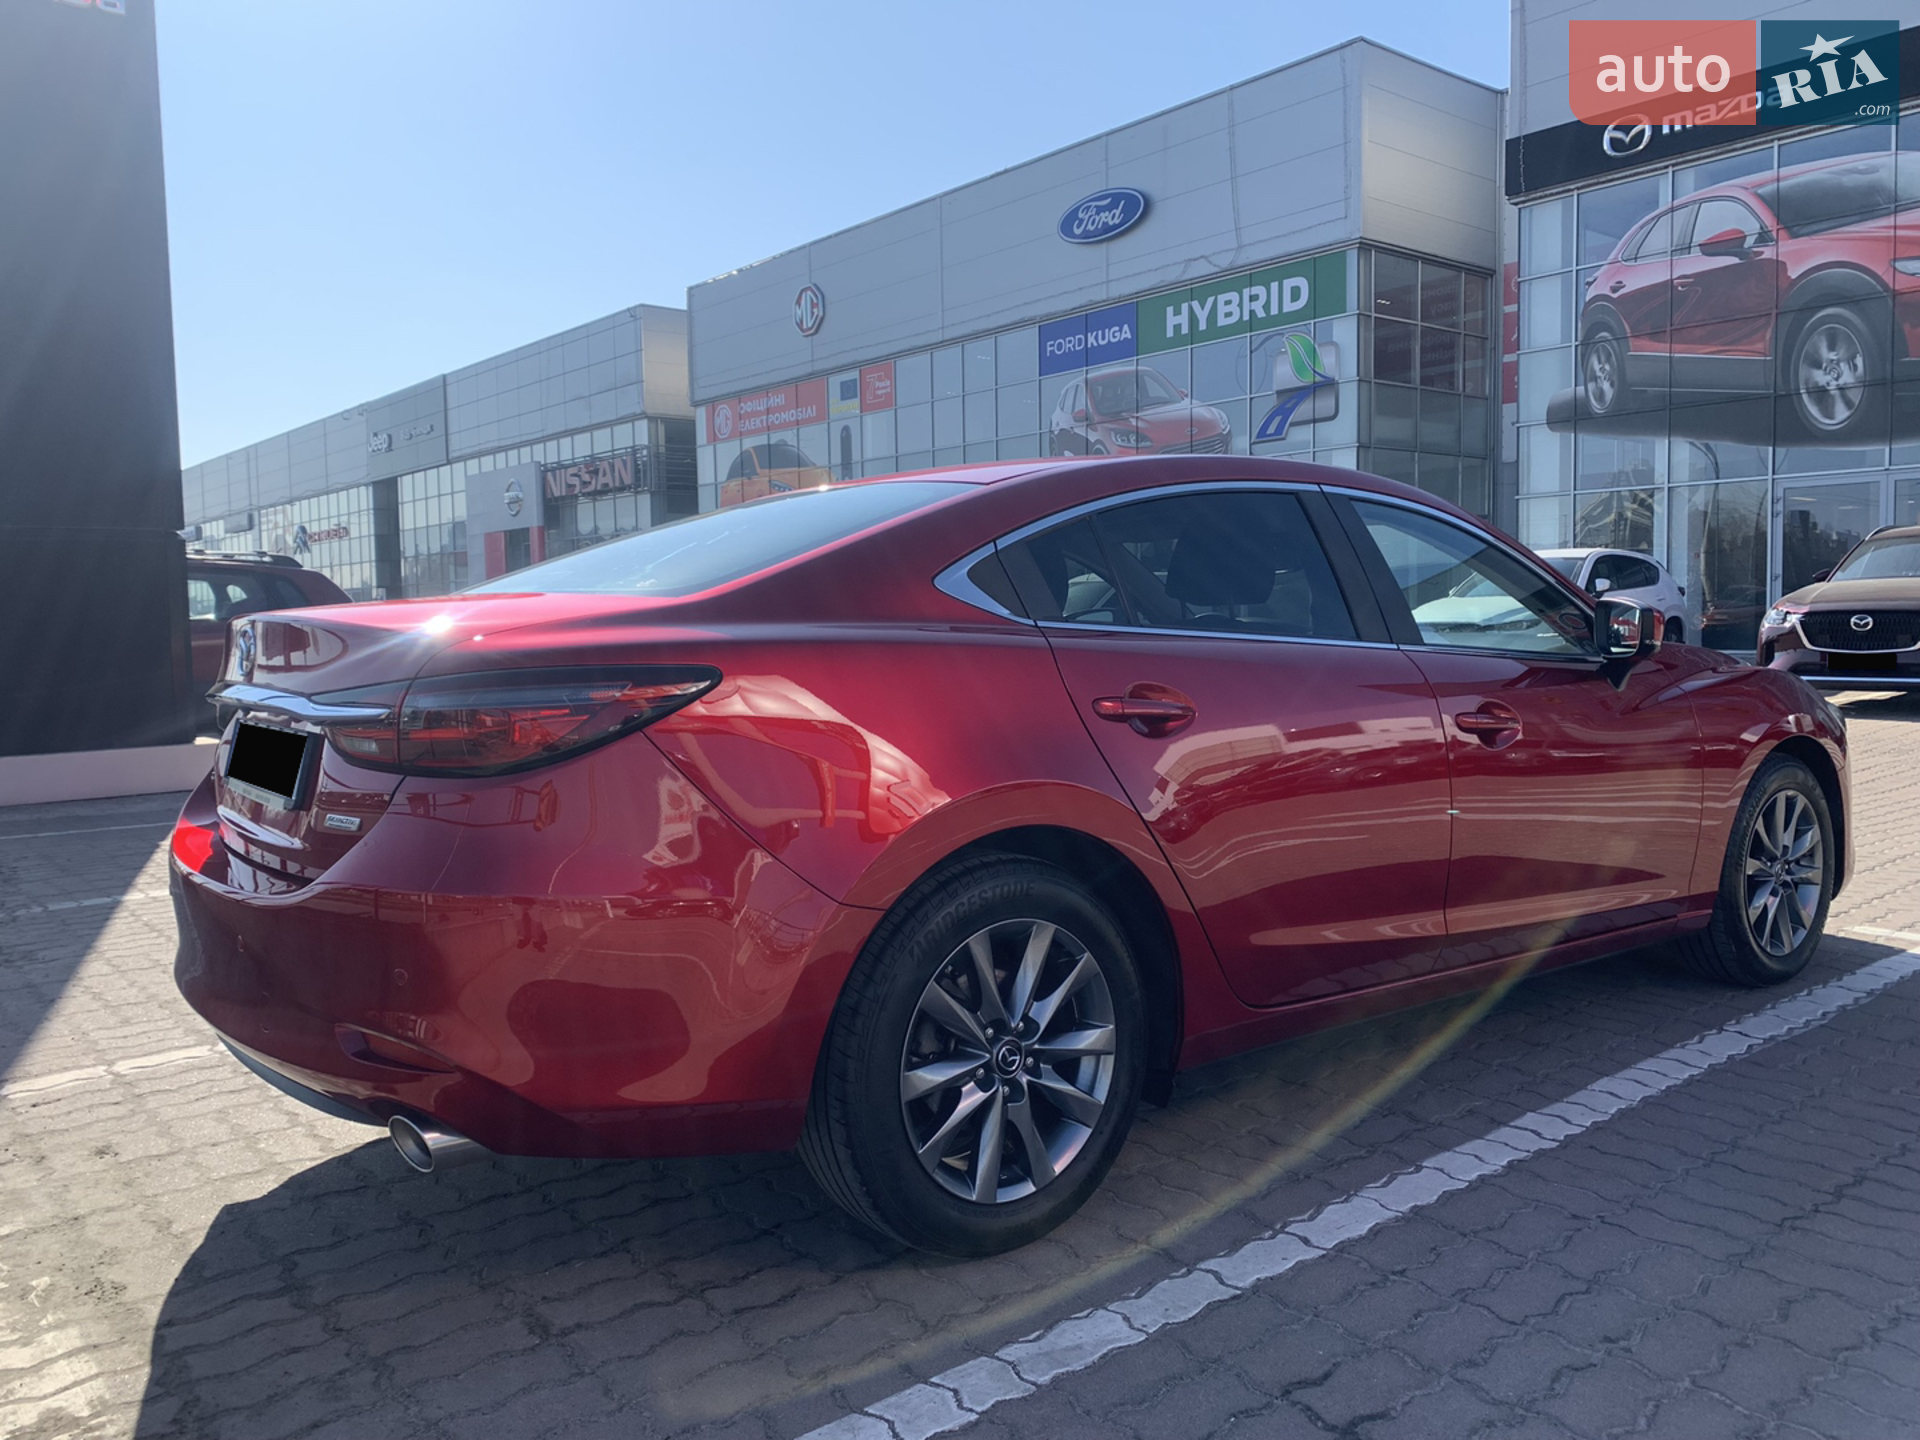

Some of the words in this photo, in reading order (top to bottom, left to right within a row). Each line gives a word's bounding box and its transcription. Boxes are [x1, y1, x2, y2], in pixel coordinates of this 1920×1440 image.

[1073, 196, 1125, 235] Ford
[796, 290, 819, 329] MG
[1166, 276, 1310, 338] HYBRID
[1046, 334, 1086, 357] FORD
[1087, 323, 1132, 349] KUGA
[739, 393, 785, 414] ОФІЦІЙНІ
[740, 405, 817, 432] ЕЛЕКТРОМОБІЛІ
[368, 431, 391, 453] Jeep
[545, 455, 635, 499] NISSAN
